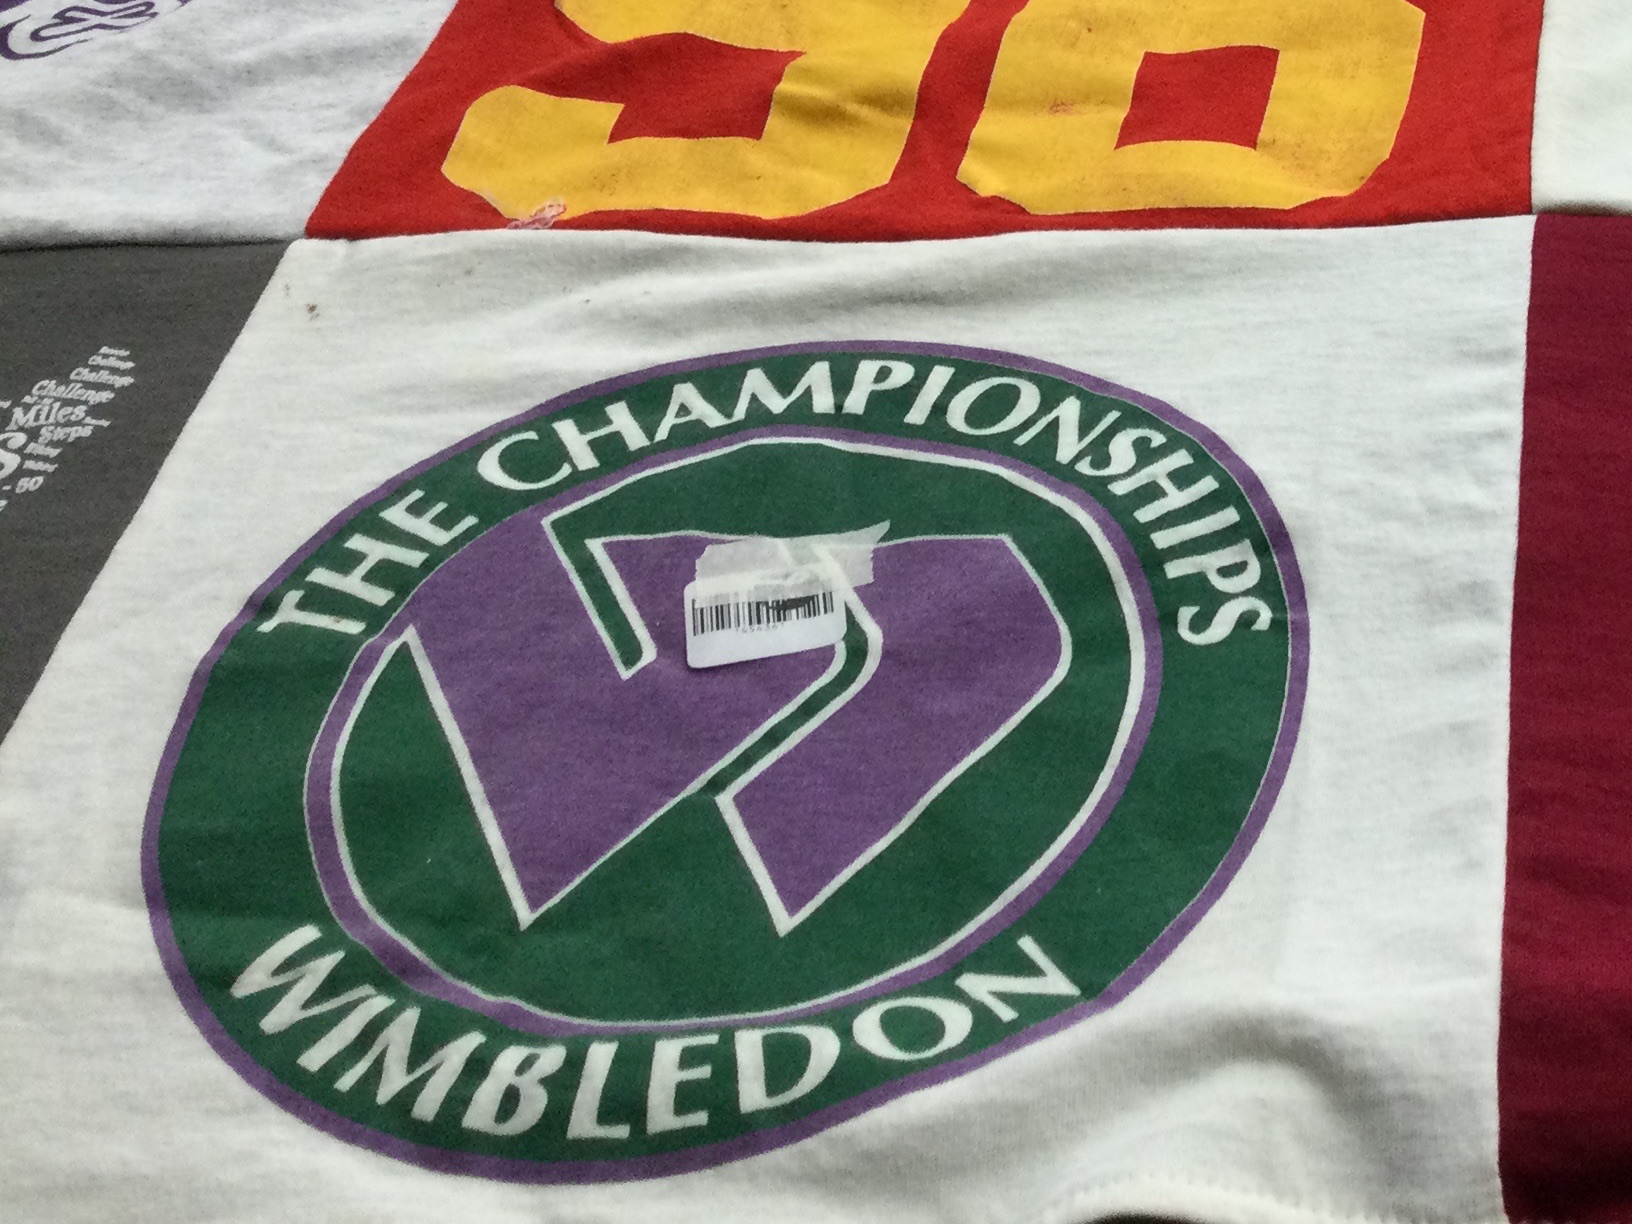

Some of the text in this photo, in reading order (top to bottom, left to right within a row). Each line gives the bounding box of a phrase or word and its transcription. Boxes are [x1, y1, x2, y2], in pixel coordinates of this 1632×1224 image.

[5, 401, 88, 431] Miles
[31, 379, 115, 406] Challenge
[257, 358, 1273, 647] THE CHAMPIONSHIPS
[230, 923, 1083, 1141] WIMBLEDON
